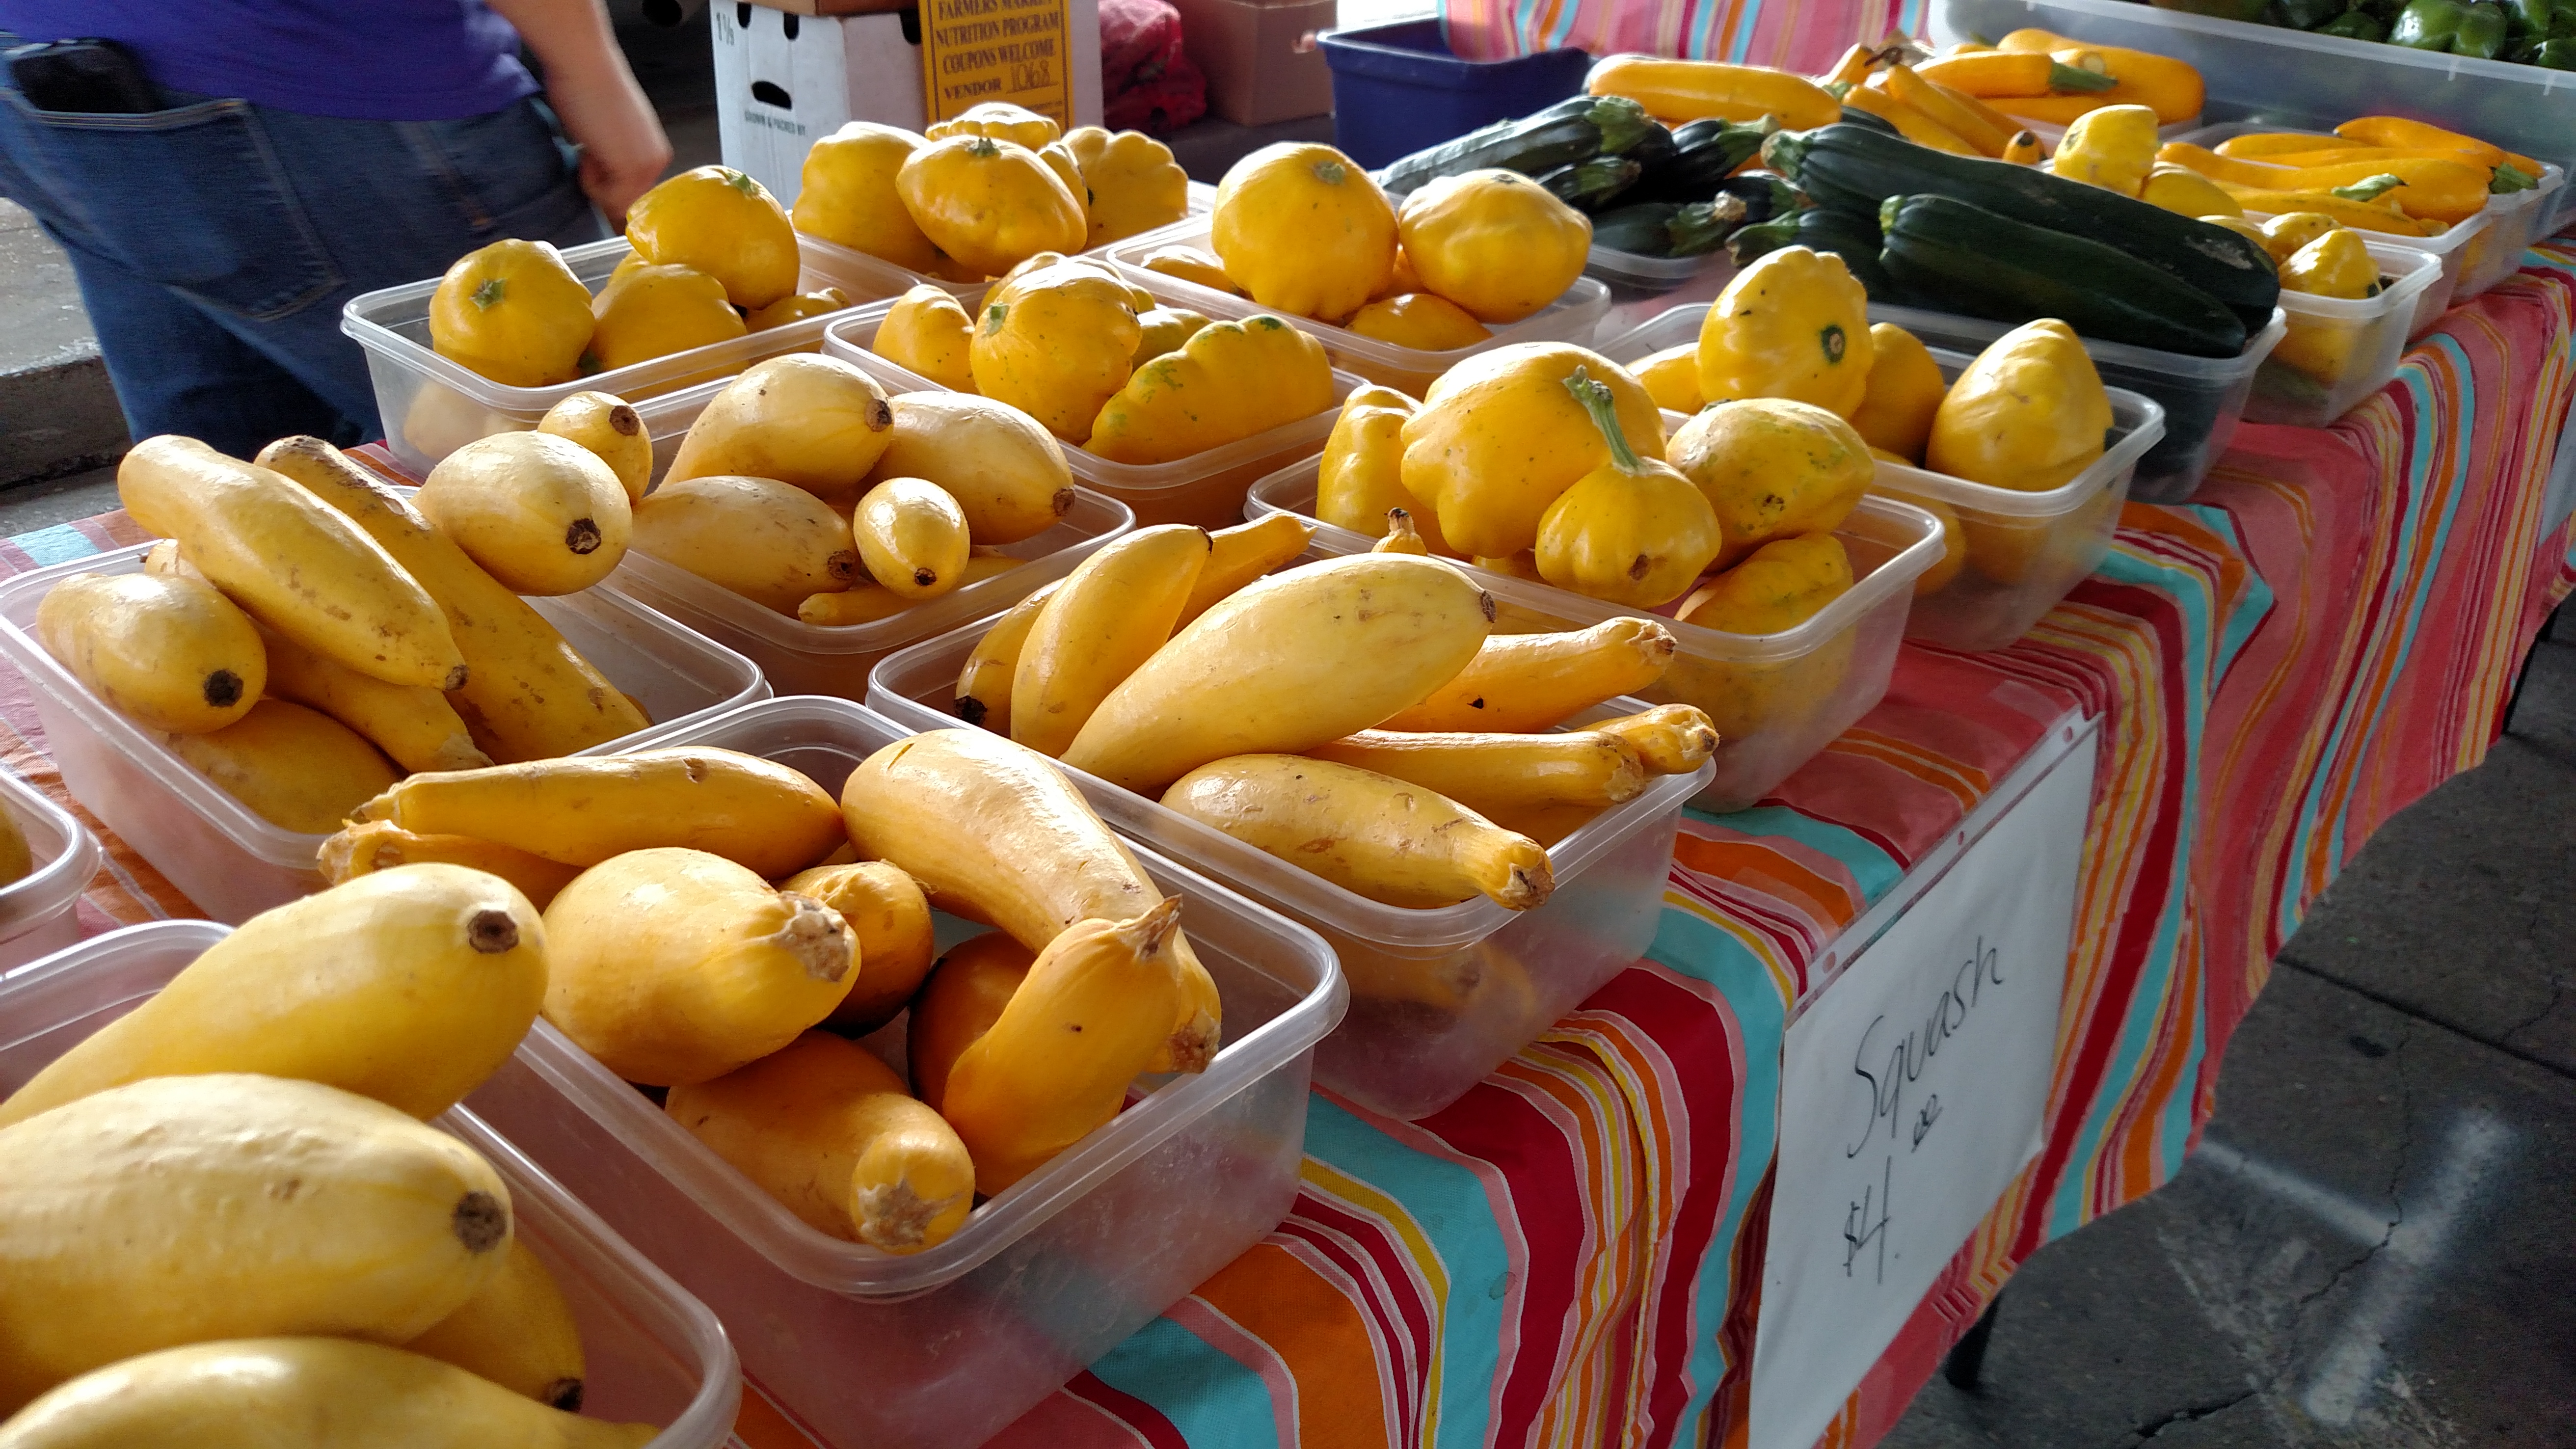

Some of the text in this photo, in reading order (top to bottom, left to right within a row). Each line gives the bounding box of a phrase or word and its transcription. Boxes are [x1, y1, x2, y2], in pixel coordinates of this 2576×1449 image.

[936, 12, 1059, 48] NUTRITION PROGRAM
[943, 38, 1056, 75] COUPONS WELCOME
[944, 78, 1001, 100] VENDOR
[1847, 935, 2003, 1159] Squash
